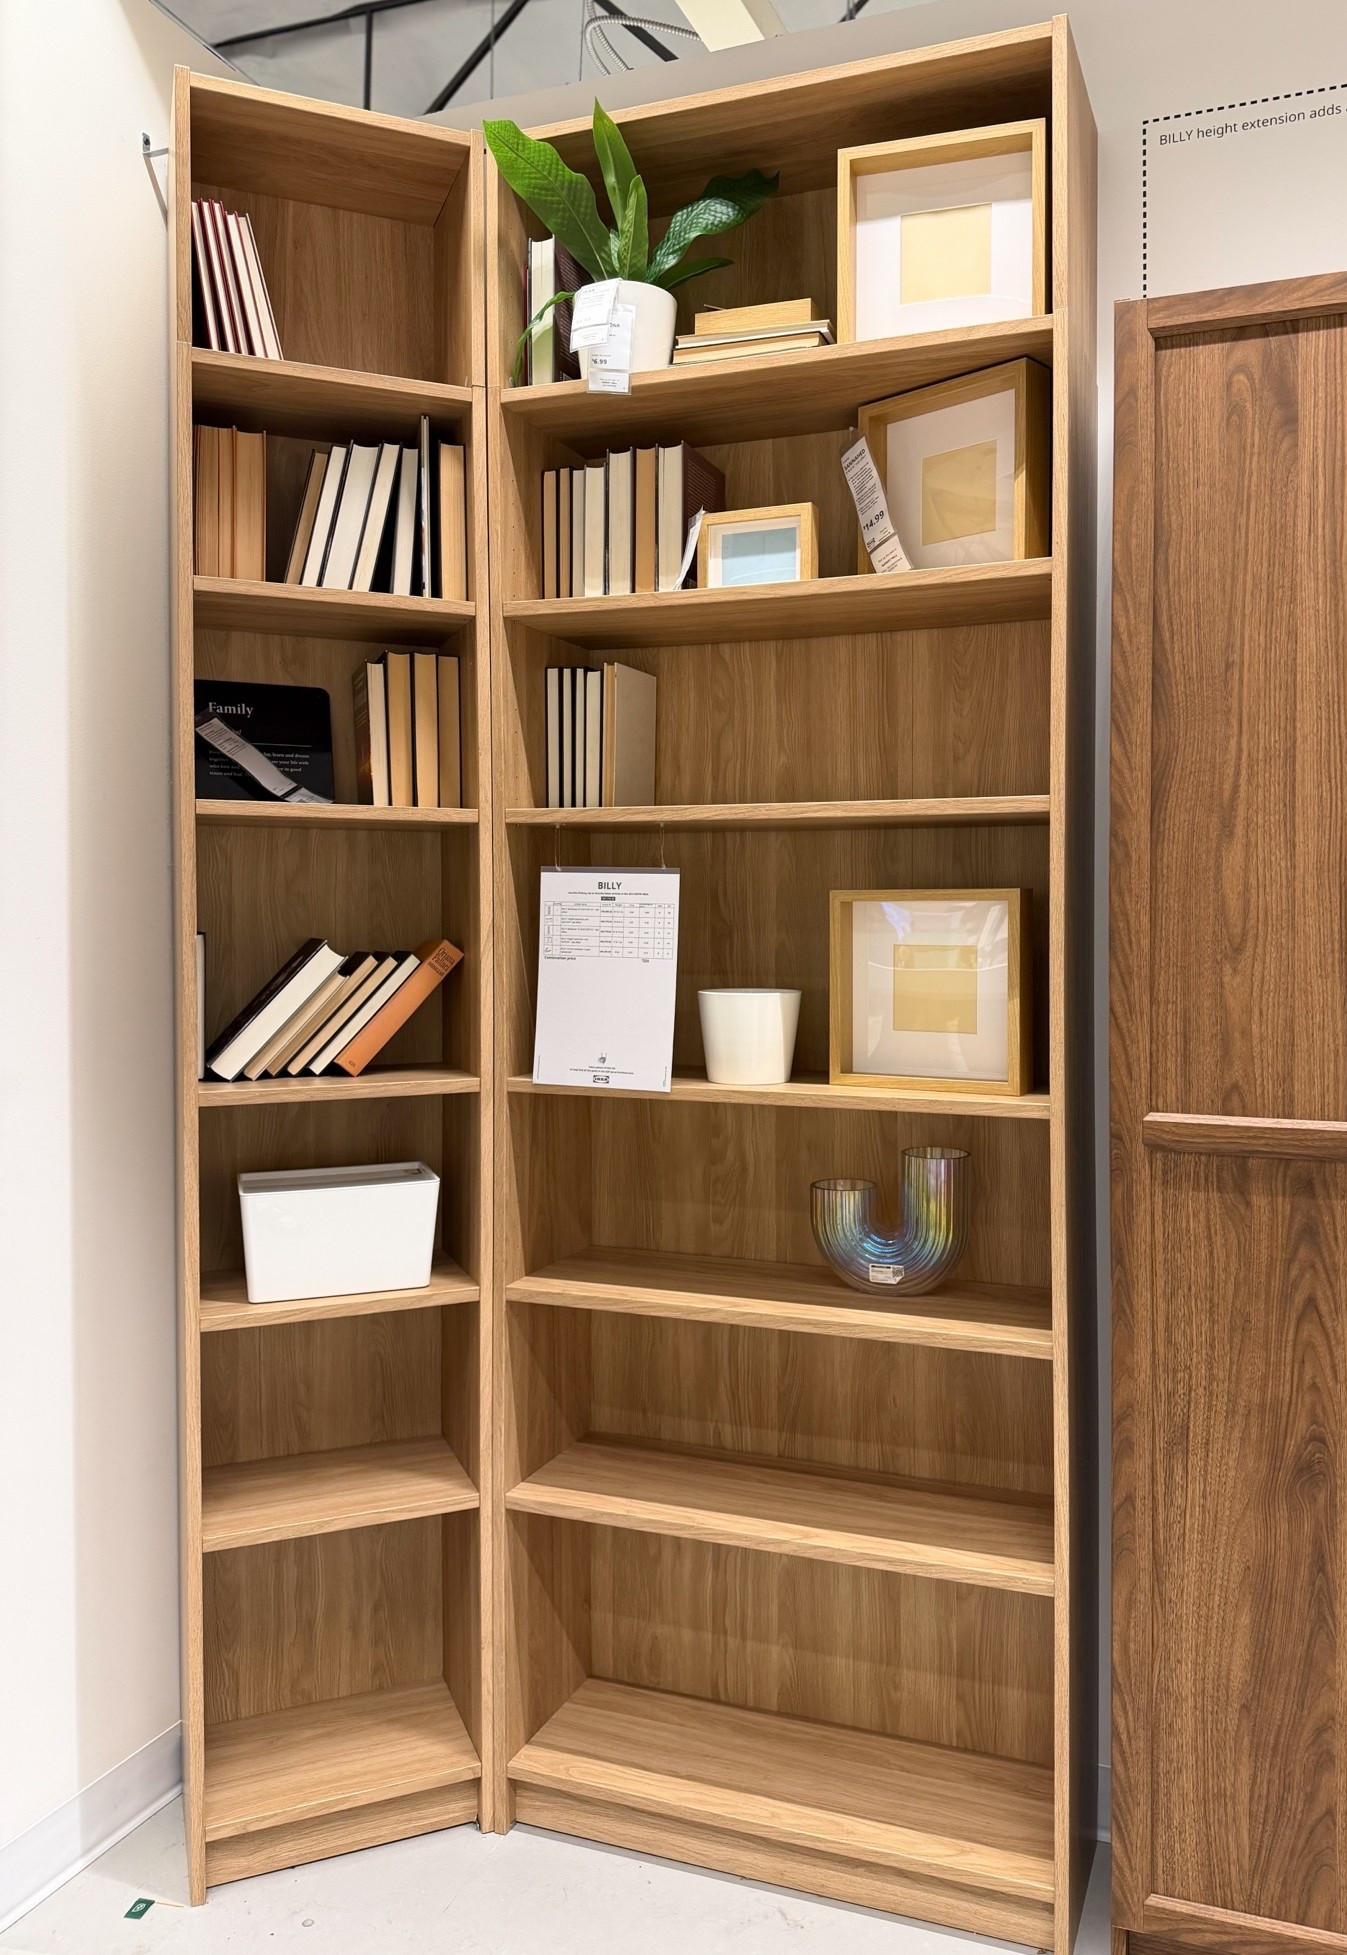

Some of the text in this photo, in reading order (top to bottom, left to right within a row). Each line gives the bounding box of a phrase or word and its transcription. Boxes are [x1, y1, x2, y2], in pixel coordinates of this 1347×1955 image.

[1159, 104, 1342, 146] BILLY height extension adds
[208, 702, 254, 718] Family
[598, 882, 622, 890] BILLY
